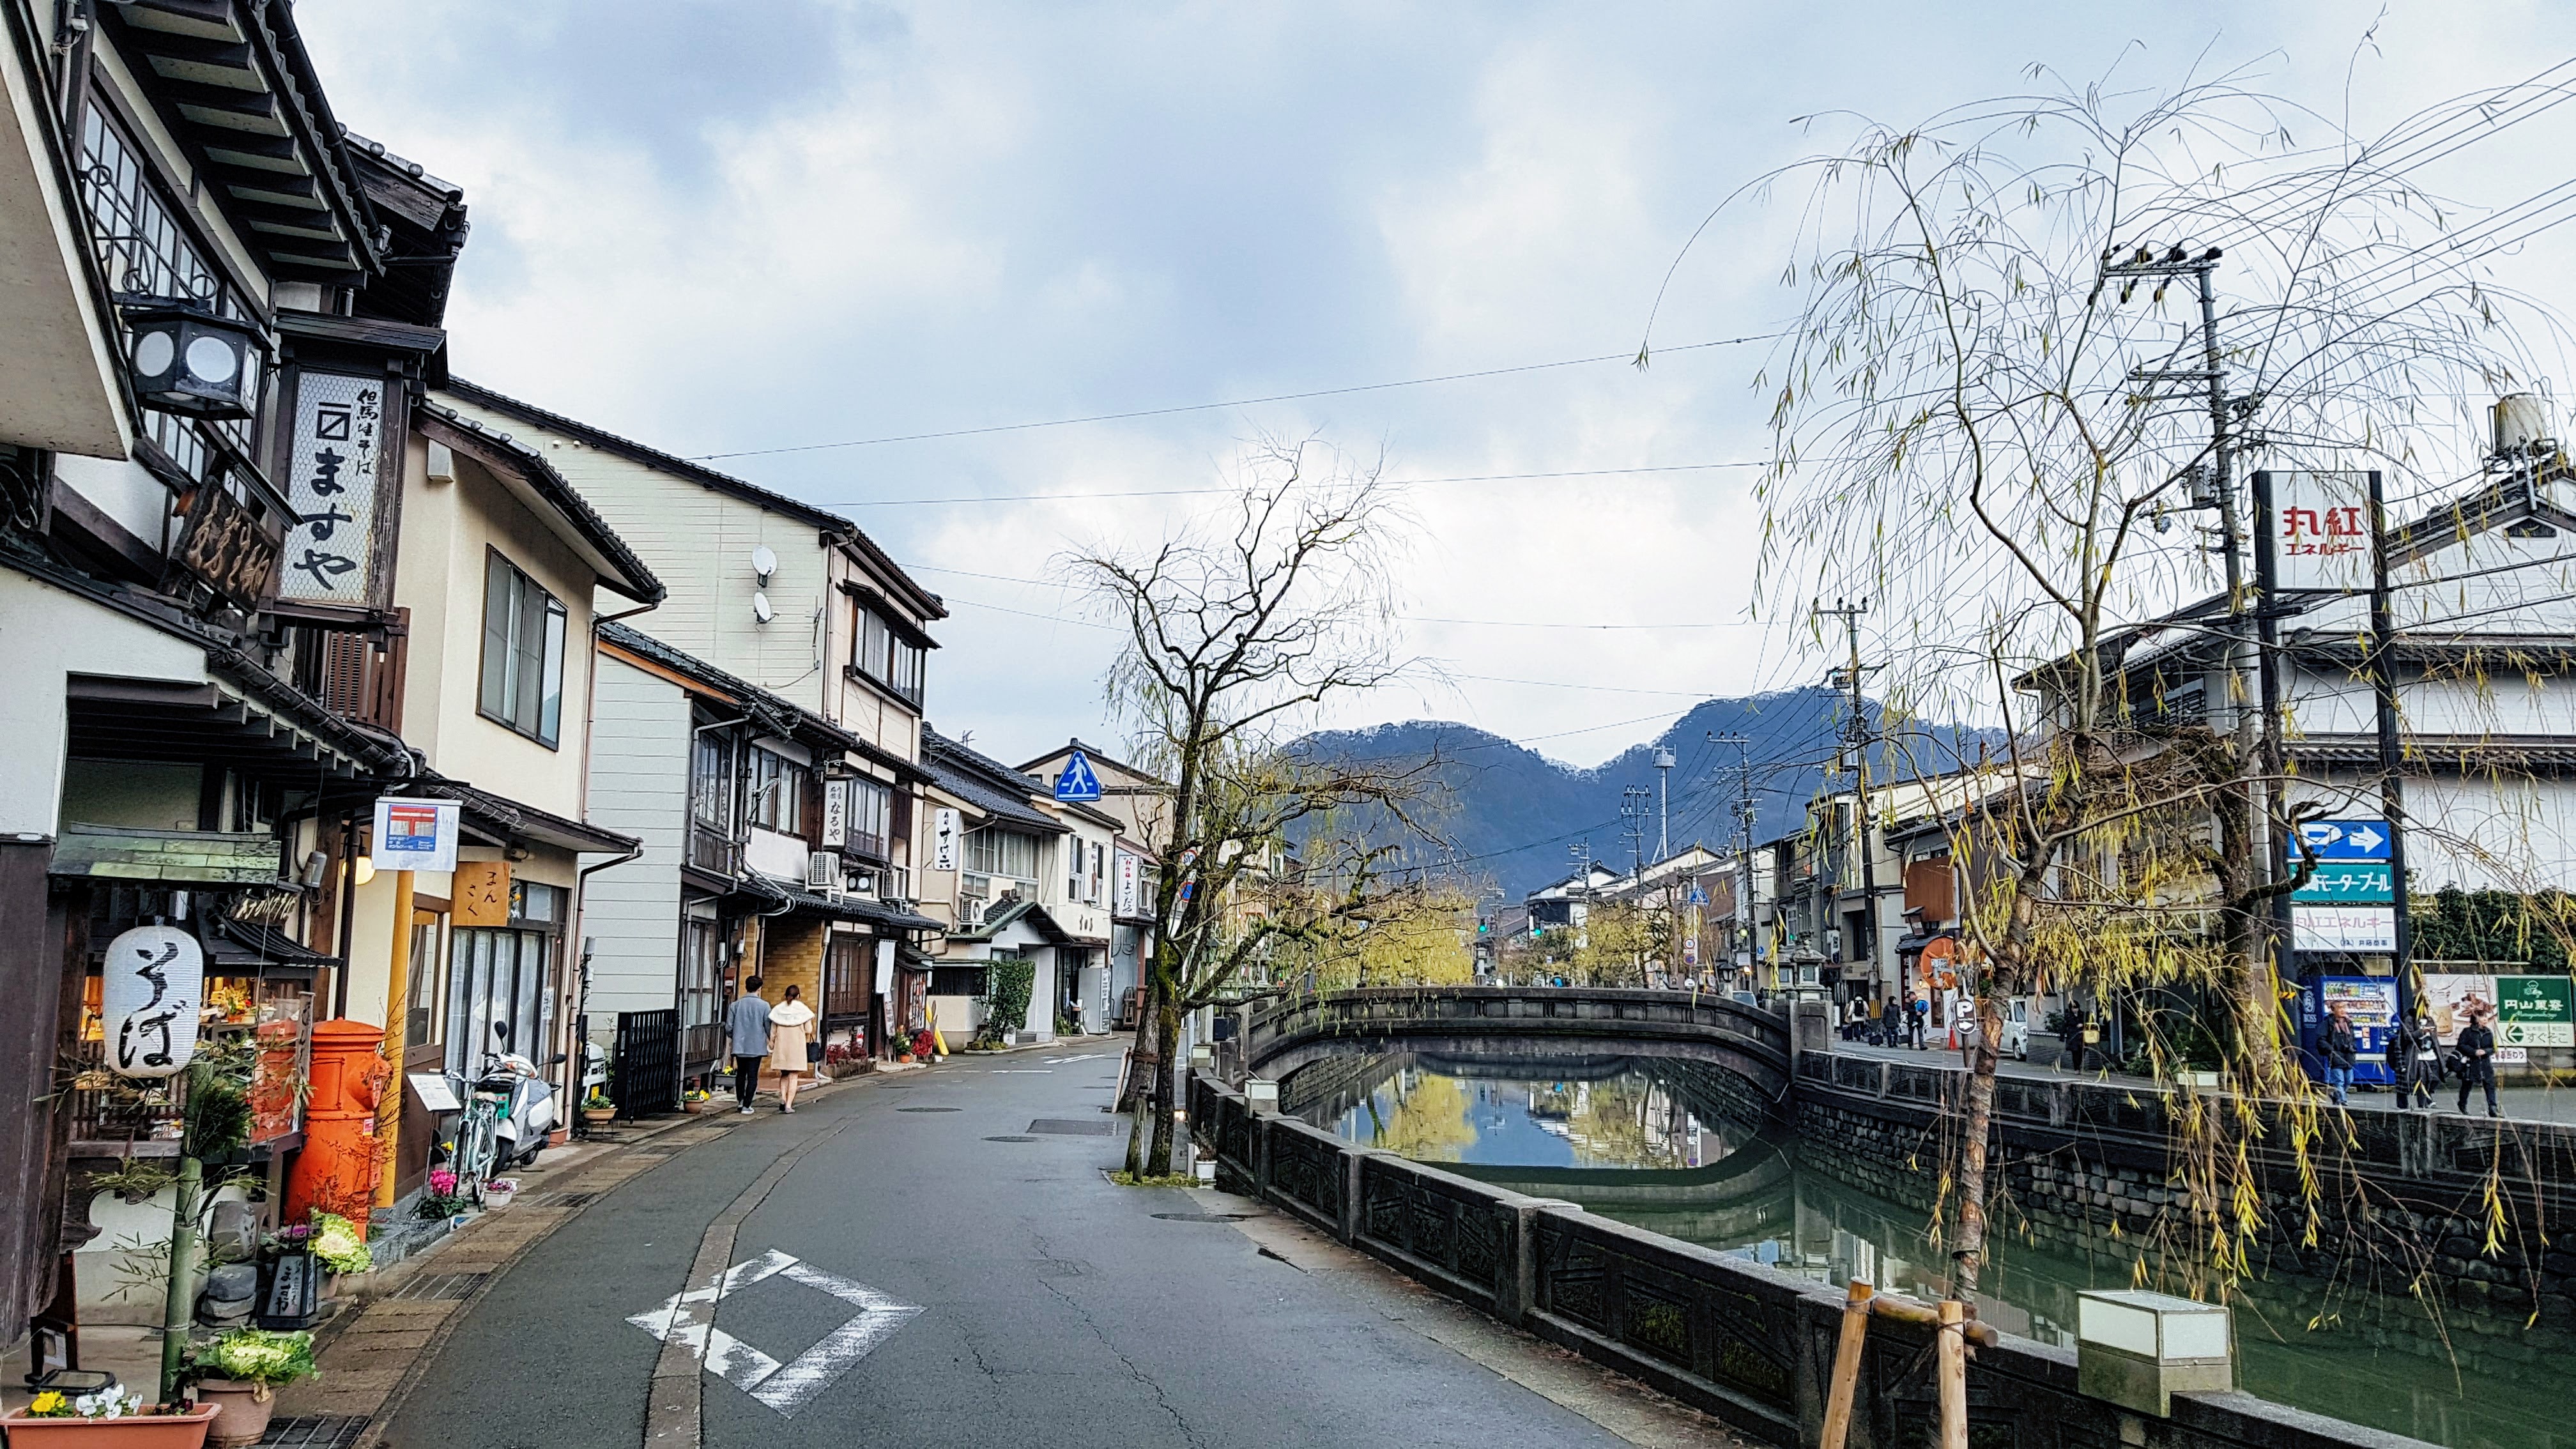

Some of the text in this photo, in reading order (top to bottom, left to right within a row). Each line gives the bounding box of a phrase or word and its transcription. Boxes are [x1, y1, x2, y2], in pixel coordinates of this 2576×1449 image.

[293, 447, 356, 591] ますや
[2294, 823, 2343, 855] P
[467, 884, 479, 917] さく
[484, 871, 498, 903] まん
[118, 942, 189, 1069] そば
[1956, 1001, 1974, 1017] P
